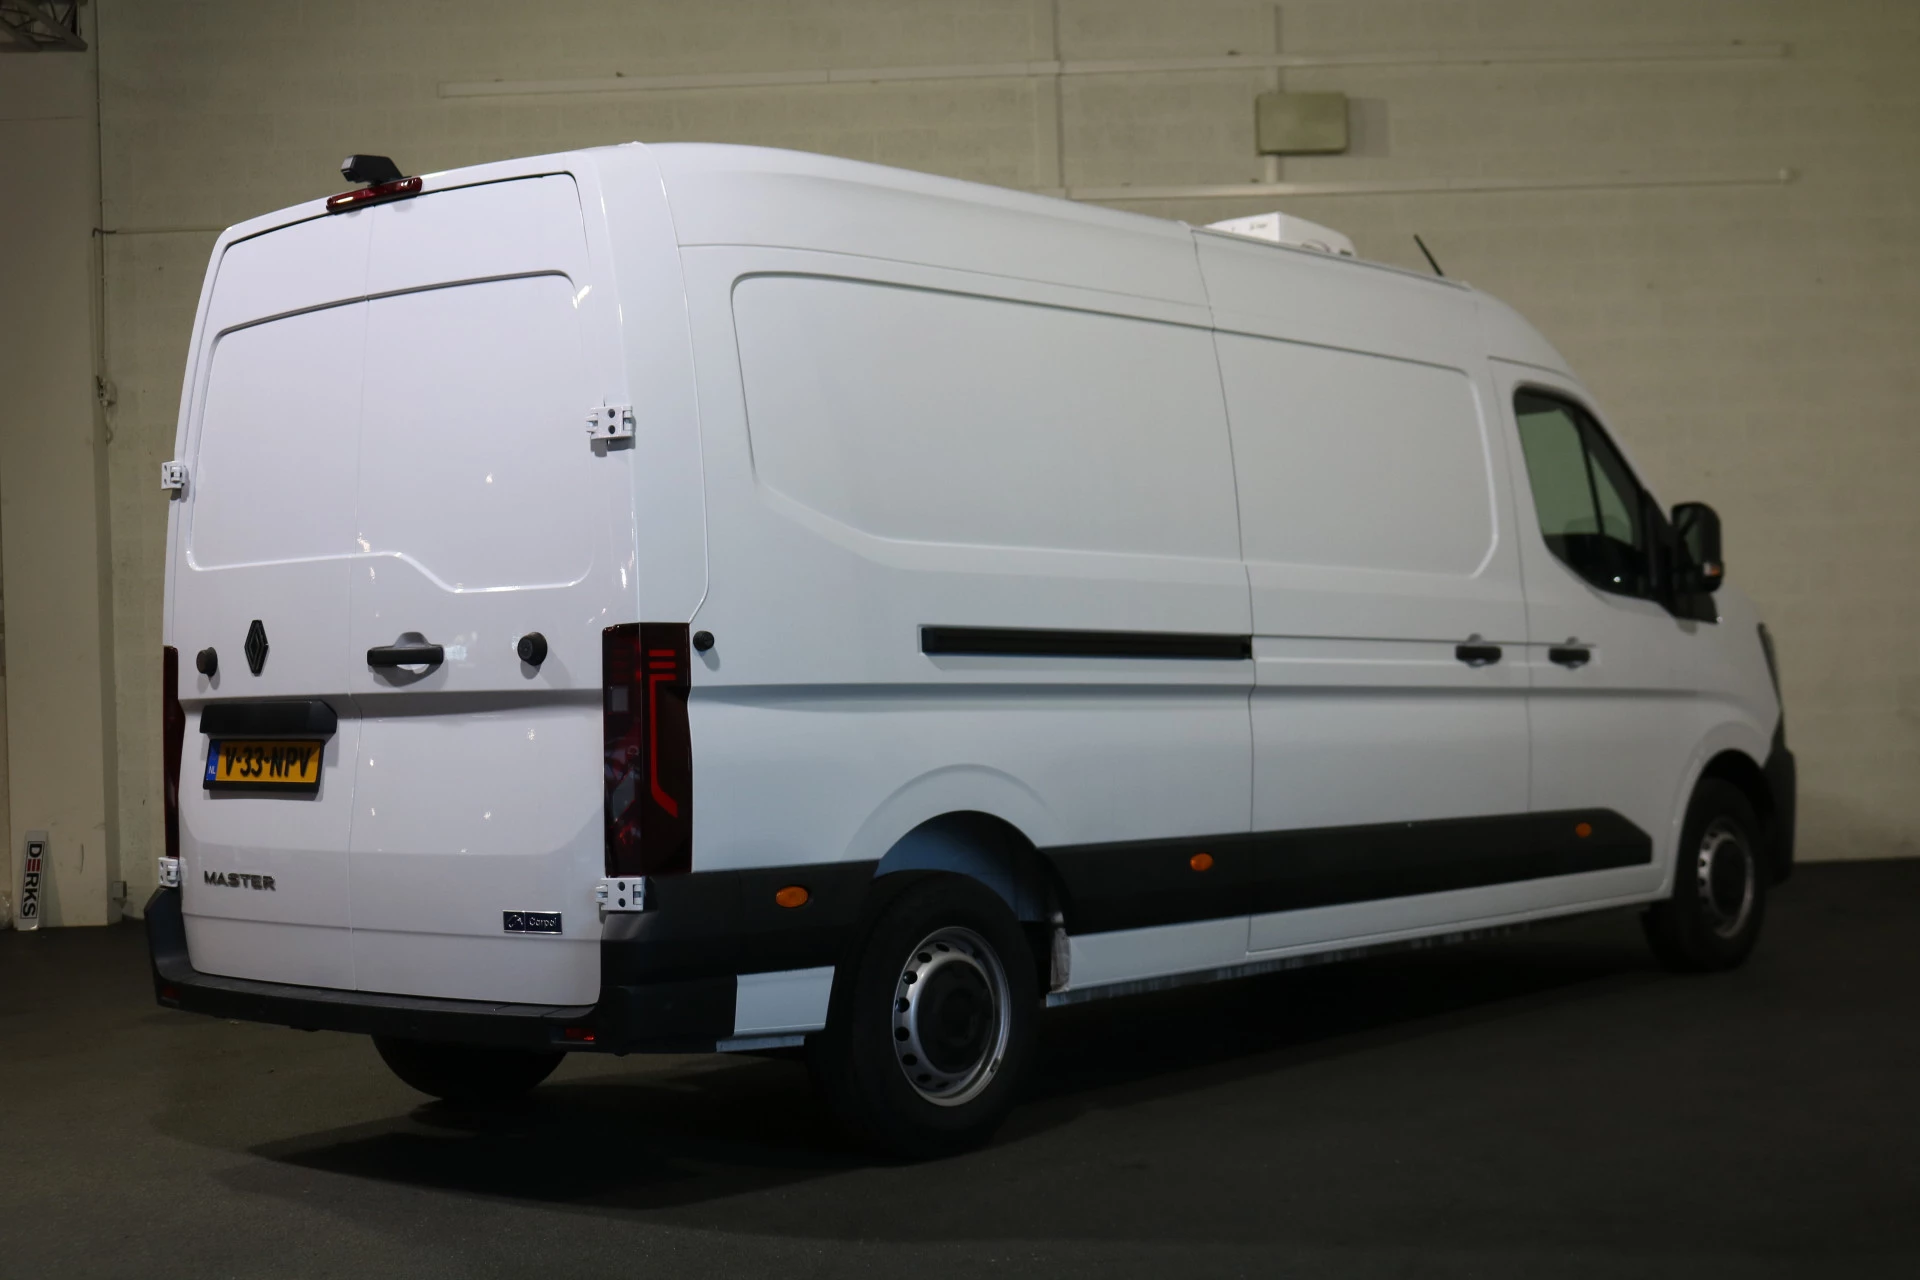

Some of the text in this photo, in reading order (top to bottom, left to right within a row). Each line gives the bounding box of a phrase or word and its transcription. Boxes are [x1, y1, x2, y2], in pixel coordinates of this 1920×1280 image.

[208, 746, 312, 778] NL V-33-NPV
[22, 843, 42, 917] DERKS
[204, 870, 276, 892] MASTER
